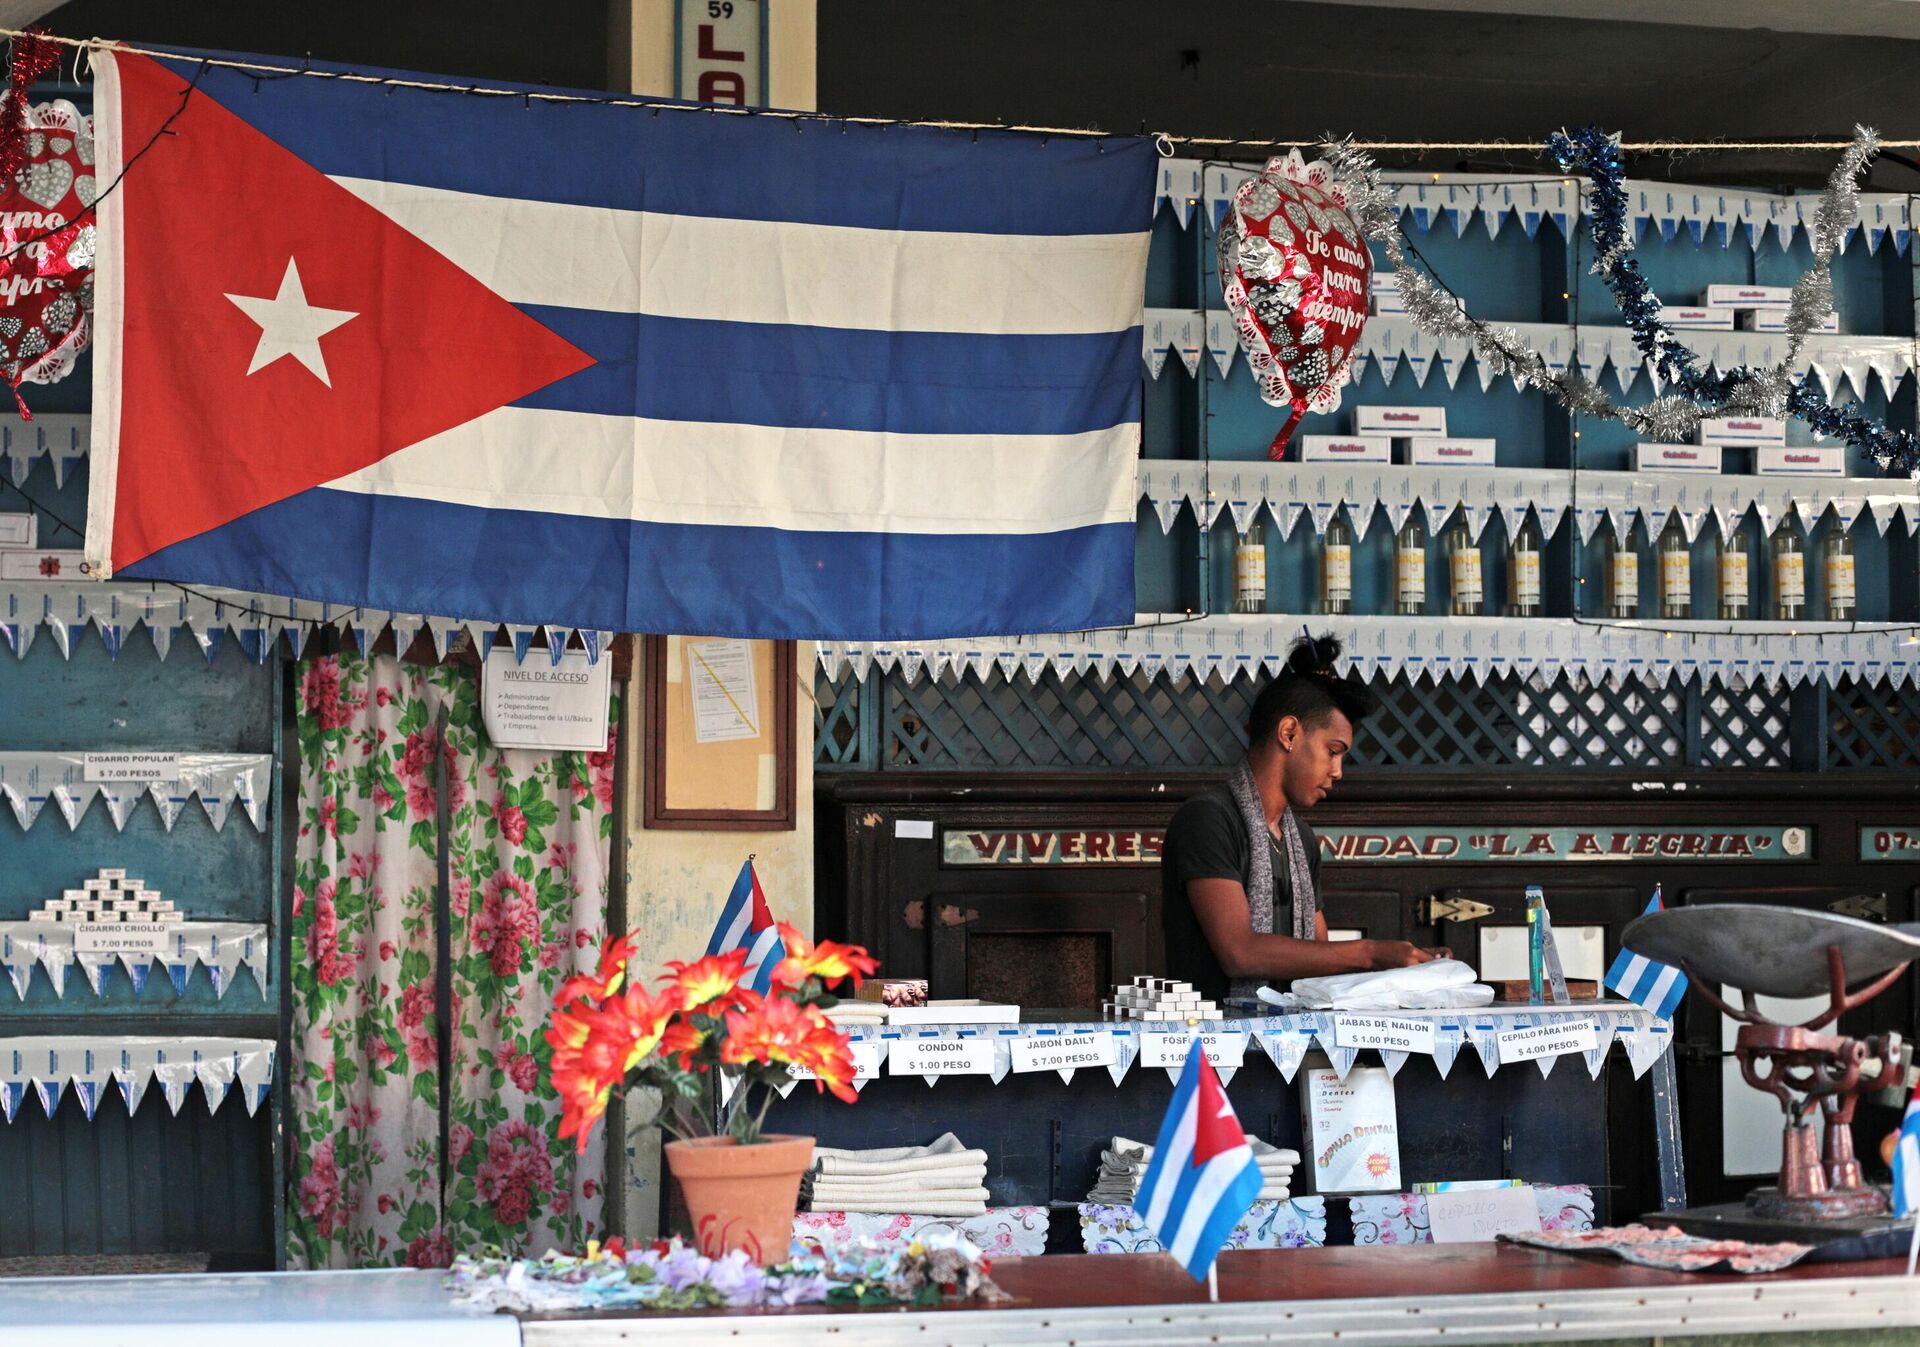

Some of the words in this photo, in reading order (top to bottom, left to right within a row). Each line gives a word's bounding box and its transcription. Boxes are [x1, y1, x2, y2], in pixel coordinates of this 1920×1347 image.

[707, 1, 733, 19] 59
[1306, 229, 1331, 258] Te
[1334, 245, 1366, 270] amo
[1322, 265, 1363, 297] para
[1303, 296, 1366, 335] siempr
[504, 670, 531, 680] NIVEL
[535, 671, 547, 681] DE
[550, 672, 589, 682] ACCESO
[504, 693, 551, 702] Administrador
[504, 703, 549, 712] Dependientes
[504, 712, 545, 722] Trabajadores
[968, 832, 1164, 862] VIVERES
[79, 925, 121, 933] CIGARRO
[124, 925, 165, 933] CRIOLLO
[1339, 1018, 1371, 1027] JABAS
[1374, 1020, 1387, 1028] DE
[1391, 1021, 1429, 1032] NAILON
[1065, 1036, 1095, 1046] DAILY
[1361, 1035, 1381, 1043] 1.00
[1383, 1037, 1410, 1046] PESO
[1501, 1031, 1536, 1042] CEPILLO
[1518, 1048, 1524, 1056] $
[1526, 1045, 1546, 1054] 4.00
[1548, 1039, 1579, 1051] PESOS
[909, 1061, 915, 1069] $
[919, 1061, 940, 1069] 1.00
[943, 1060, 971, 1069] PESO
[1032, 1058, 1038, 1066] $
[1041, 1056, 1062, 1065] 7.00
[1065, 1053, 1099, 1063] PESOS
[789, 1066, 796, 1074] $
